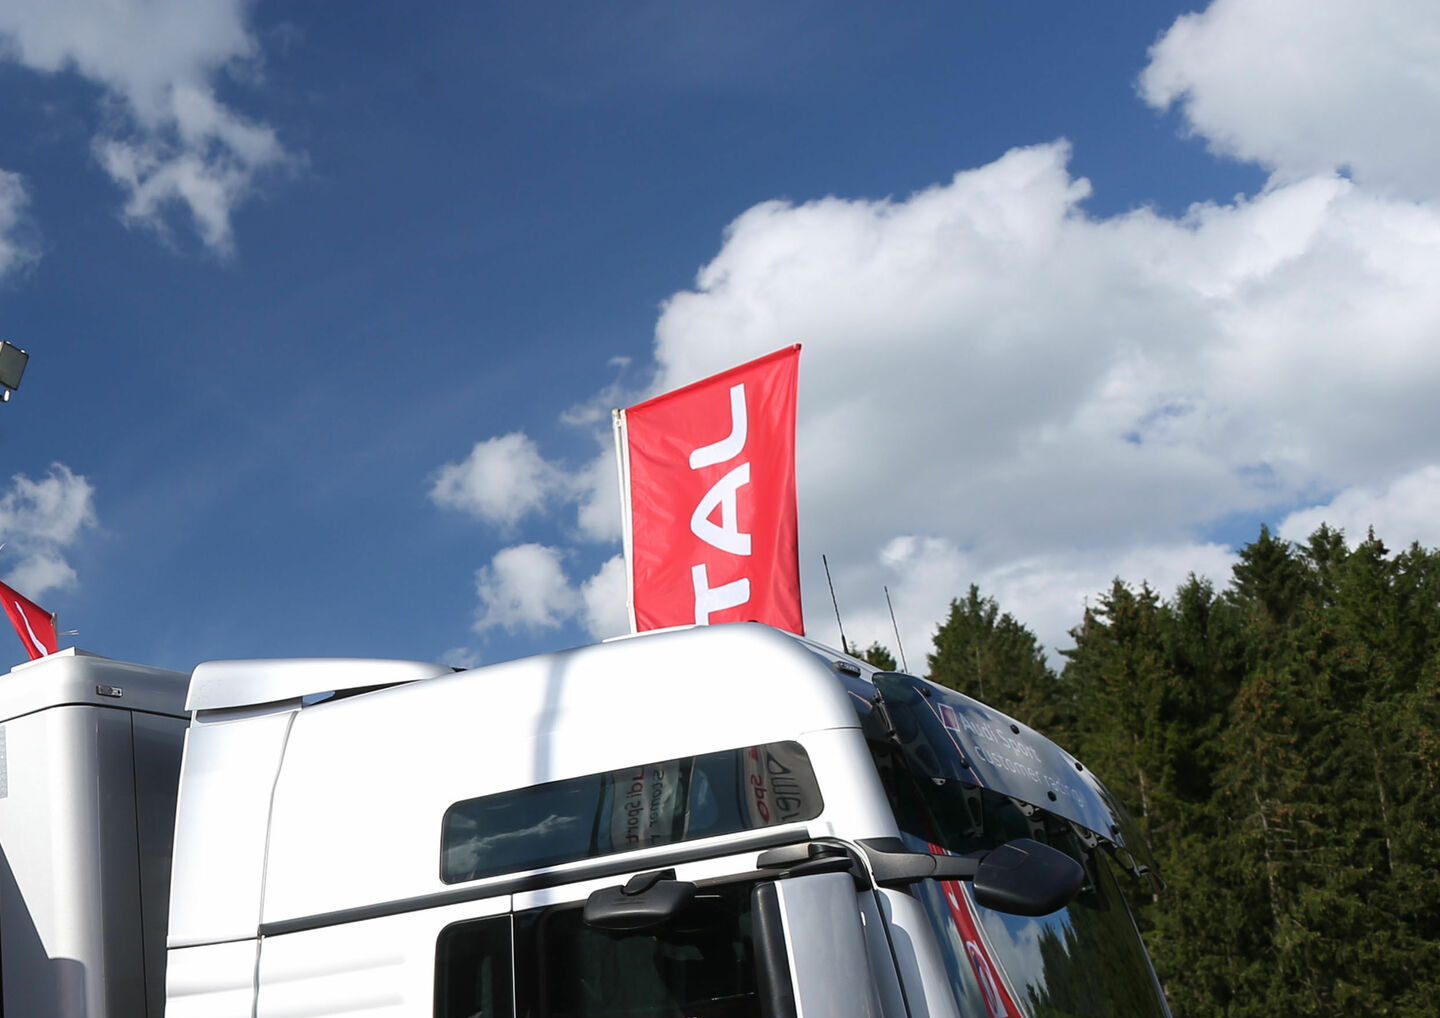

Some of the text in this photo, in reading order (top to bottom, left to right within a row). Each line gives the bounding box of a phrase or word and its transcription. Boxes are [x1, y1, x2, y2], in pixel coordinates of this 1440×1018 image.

[959, 711, 1042, 764] Audi Sport
[973, 746, 1042, 785] customer
